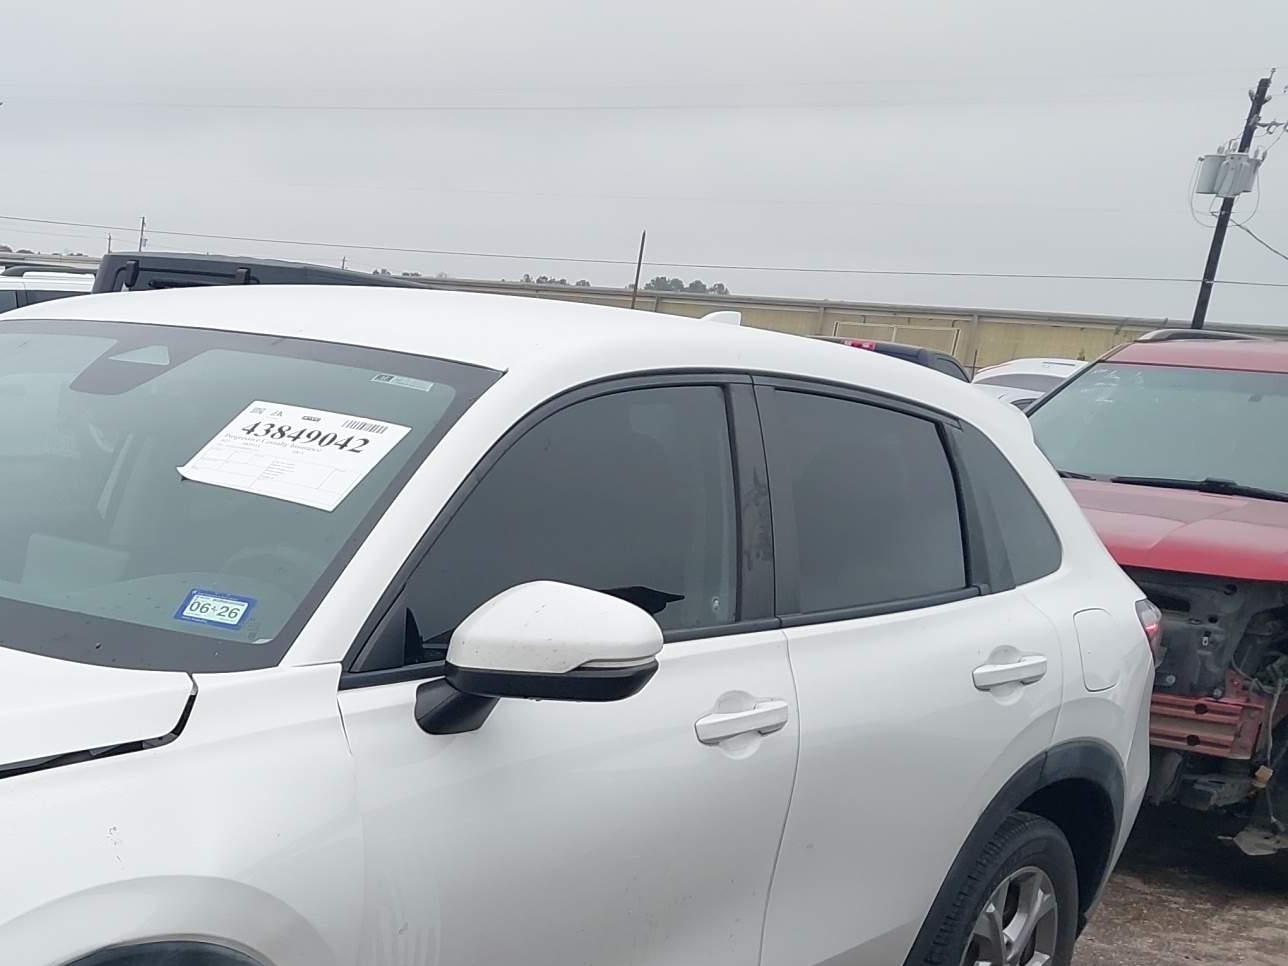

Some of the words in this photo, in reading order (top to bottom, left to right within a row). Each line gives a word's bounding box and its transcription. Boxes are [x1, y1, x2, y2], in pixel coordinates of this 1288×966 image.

[241, 421, 370, 453] 43849042
[189, 601, 211, 614] 06
[216, 605, 241, 619] 26
